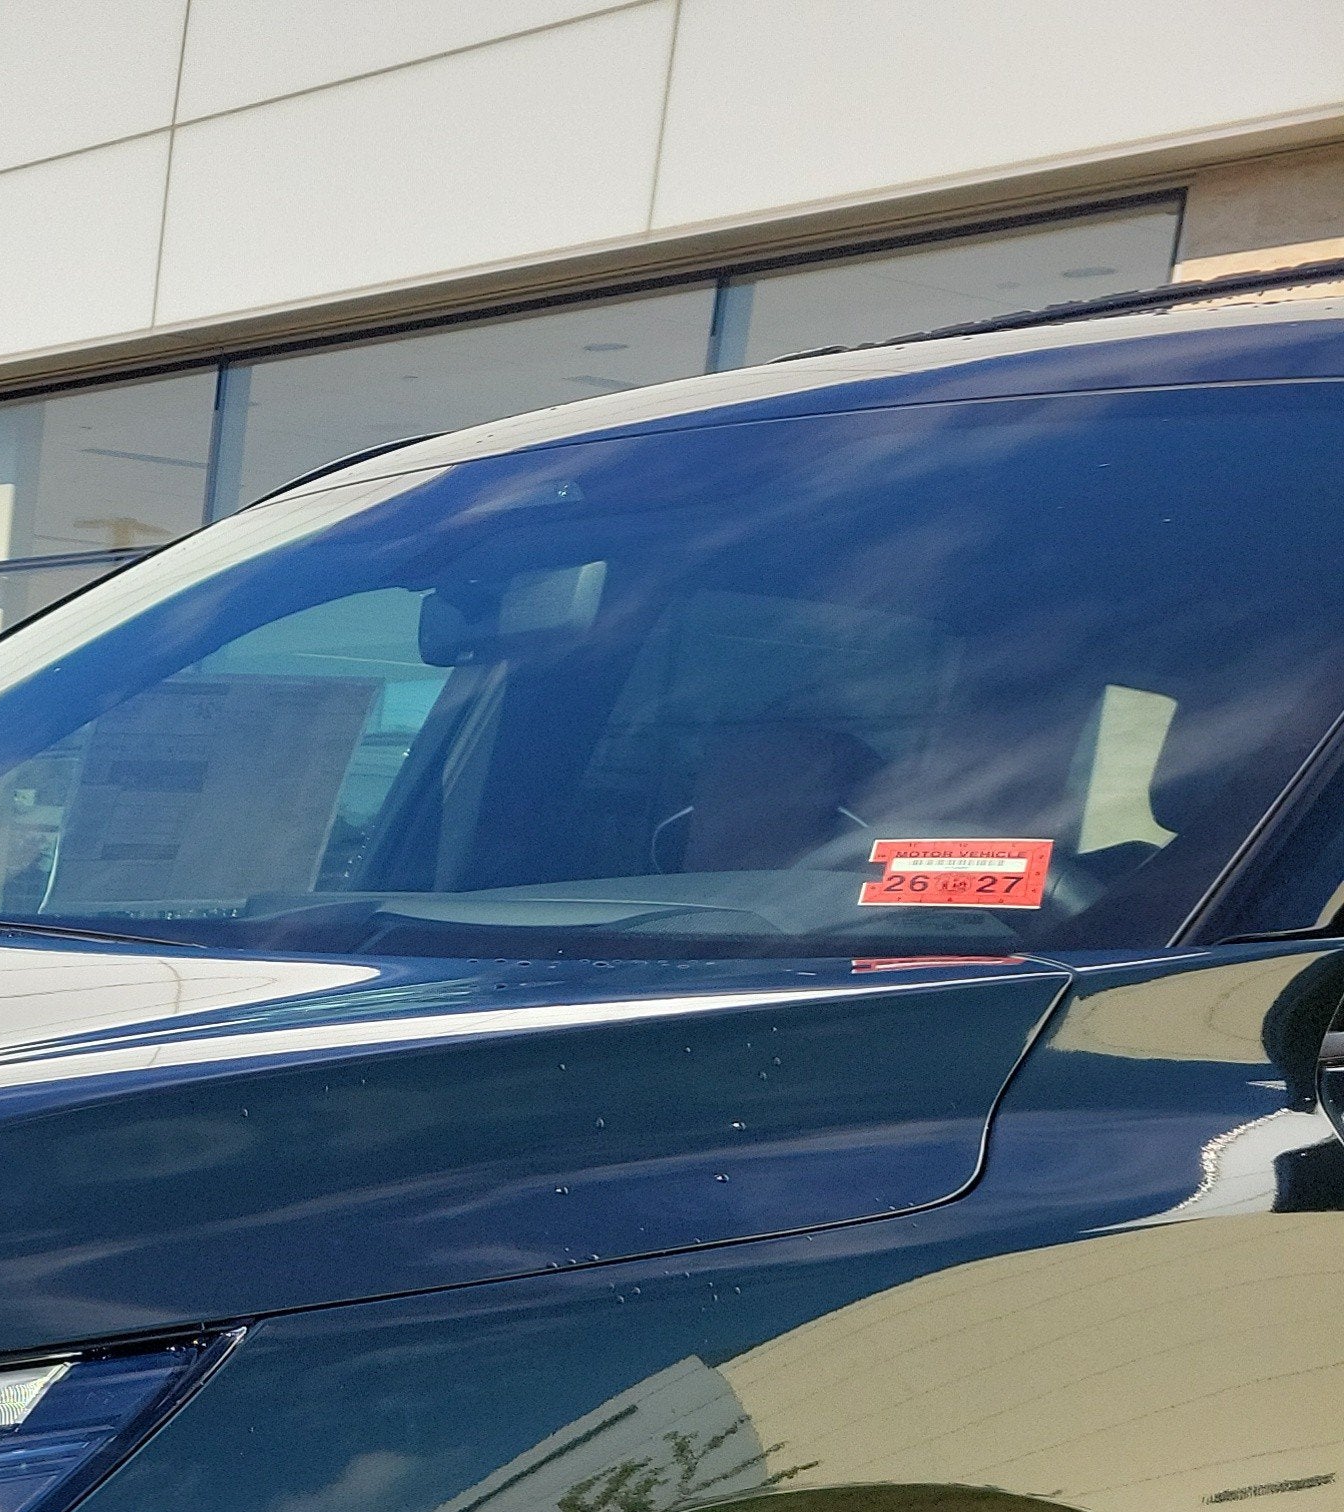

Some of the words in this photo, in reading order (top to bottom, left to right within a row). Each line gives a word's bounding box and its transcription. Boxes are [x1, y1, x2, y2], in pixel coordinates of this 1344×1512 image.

[895, 850, 954, 859] MOTOR
[959, 850, 1028, 859] VEHICLE
[883, 874, 930, 893] 26
[975, 875, 1024, 894] 27
